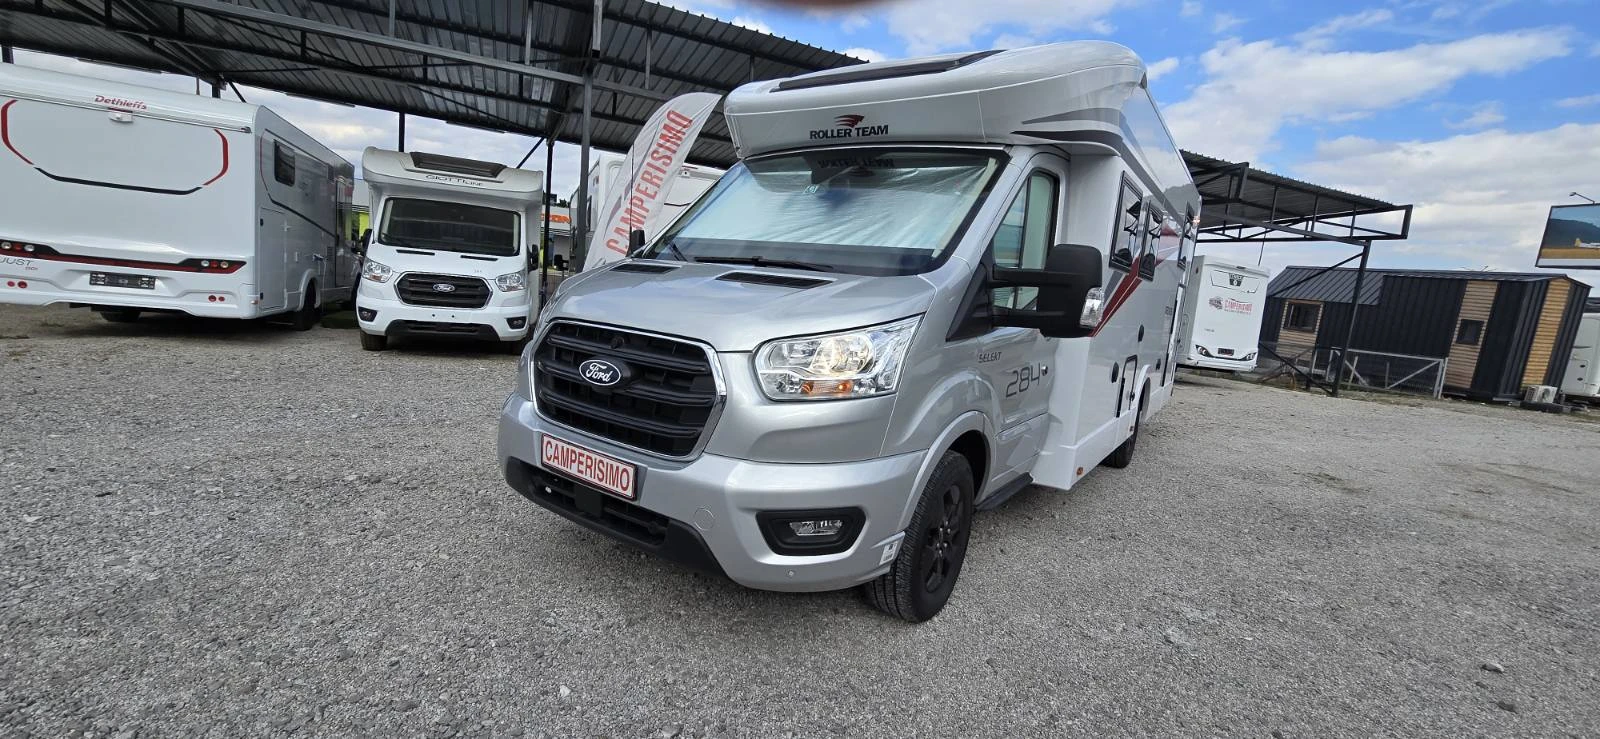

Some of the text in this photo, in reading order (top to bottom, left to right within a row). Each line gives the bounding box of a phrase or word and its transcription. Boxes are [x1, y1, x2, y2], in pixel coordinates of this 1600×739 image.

[809, 124, 889, 140] ROLLER TEAM
[585, 362, 614, 382] Ford
[1005, 362, 1041, 398] 284
[545, 440, 630, 492] CAMPERISIMO
